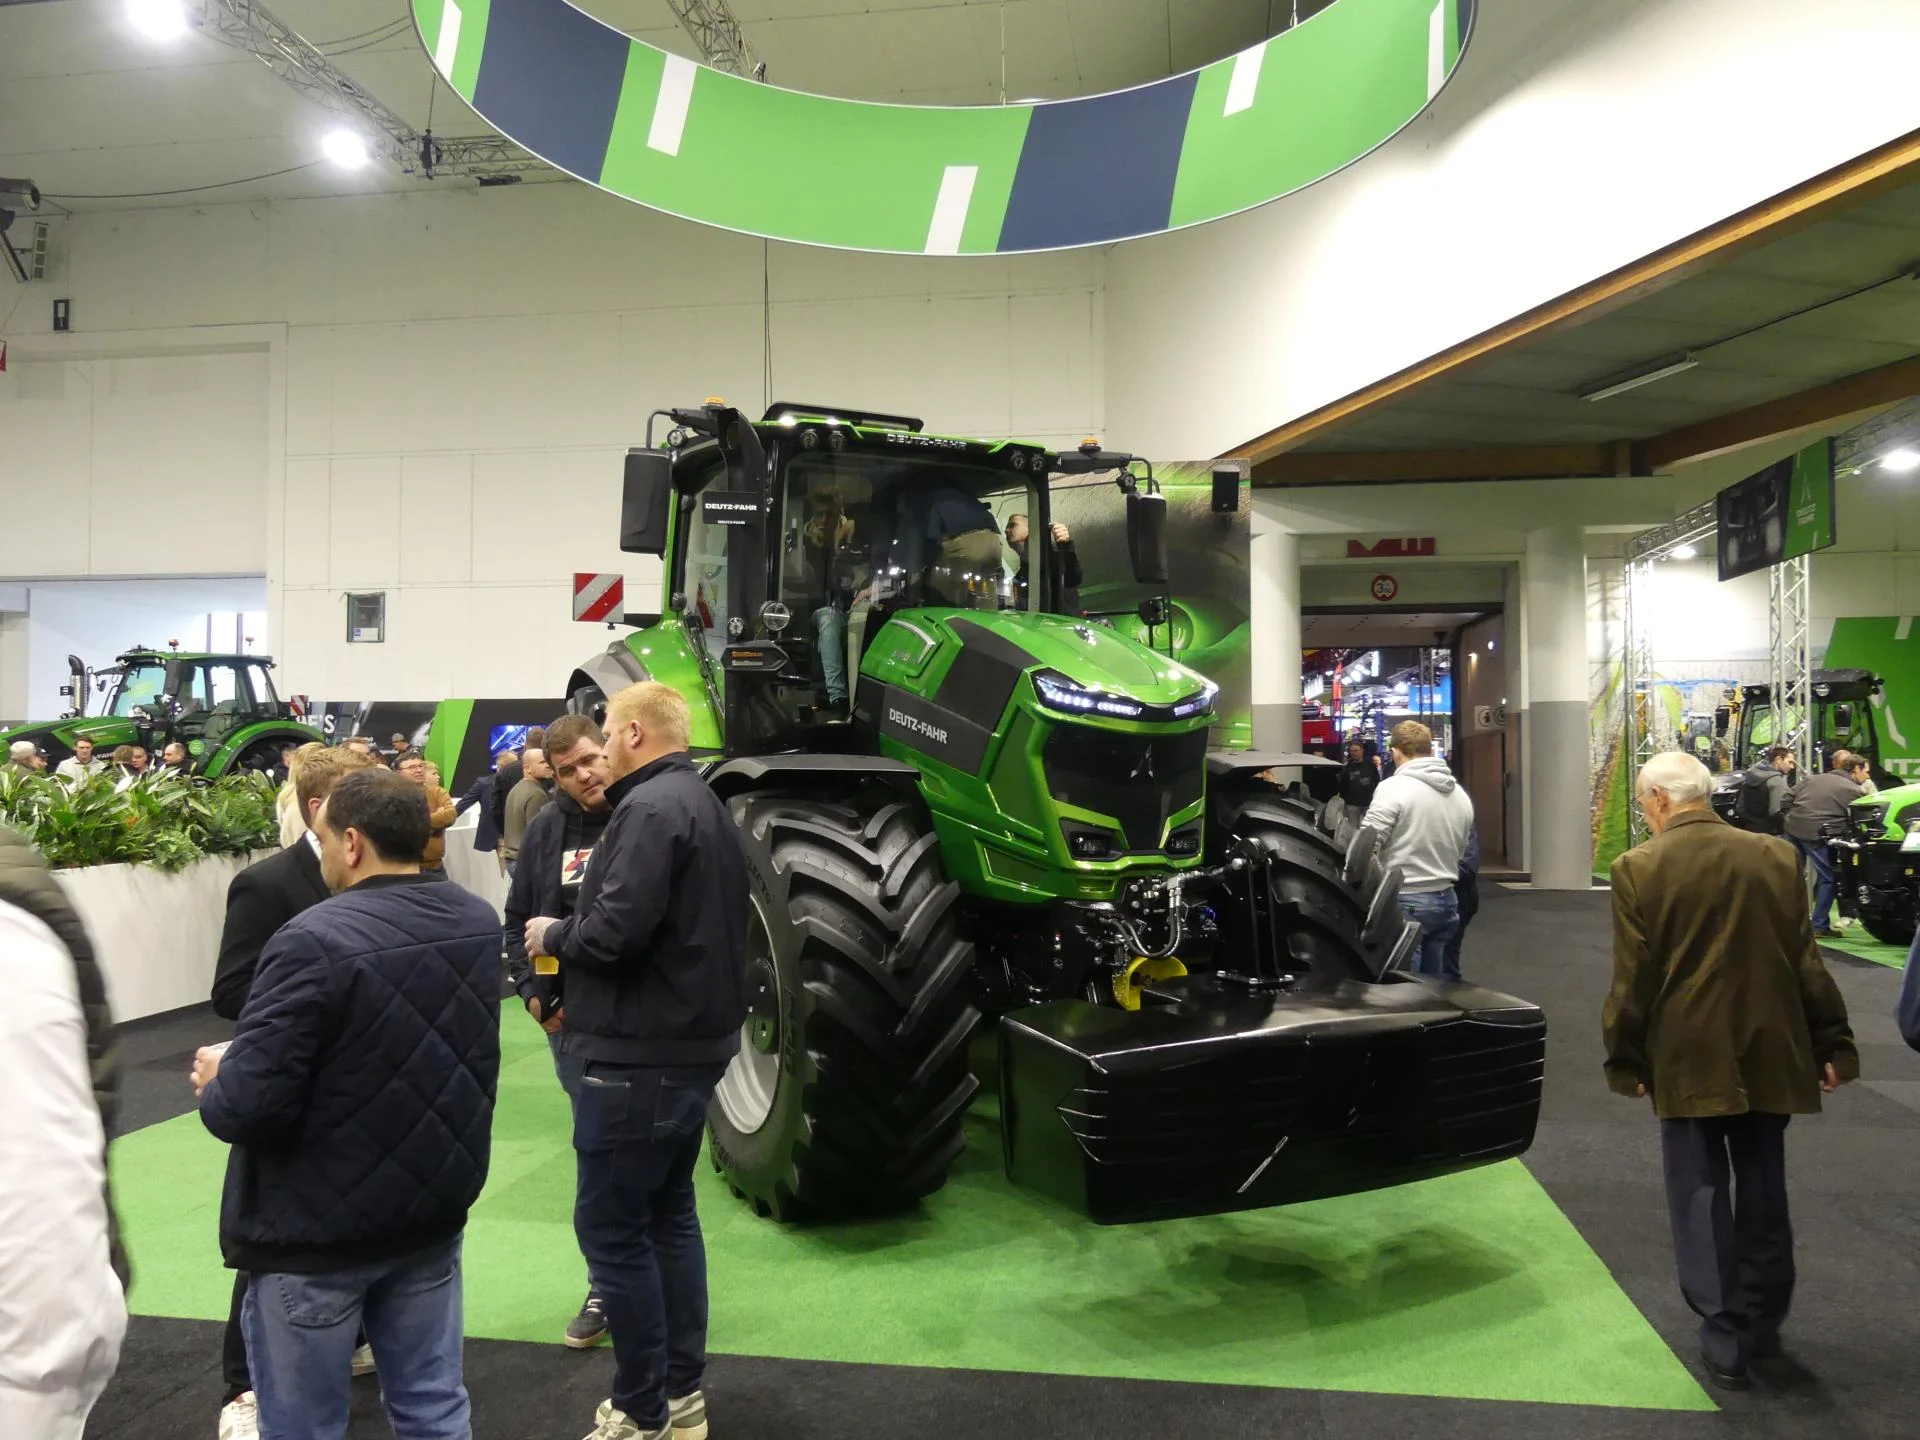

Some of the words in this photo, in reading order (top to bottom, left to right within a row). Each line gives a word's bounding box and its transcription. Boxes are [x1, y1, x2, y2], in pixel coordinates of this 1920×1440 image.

[887, 433, 967, 451] DEUTZ-FAHR
[705, 503, 757, 511] DEUTZ-FAHR
[889, 707, 948, 745] DEUTZ-FAHR
